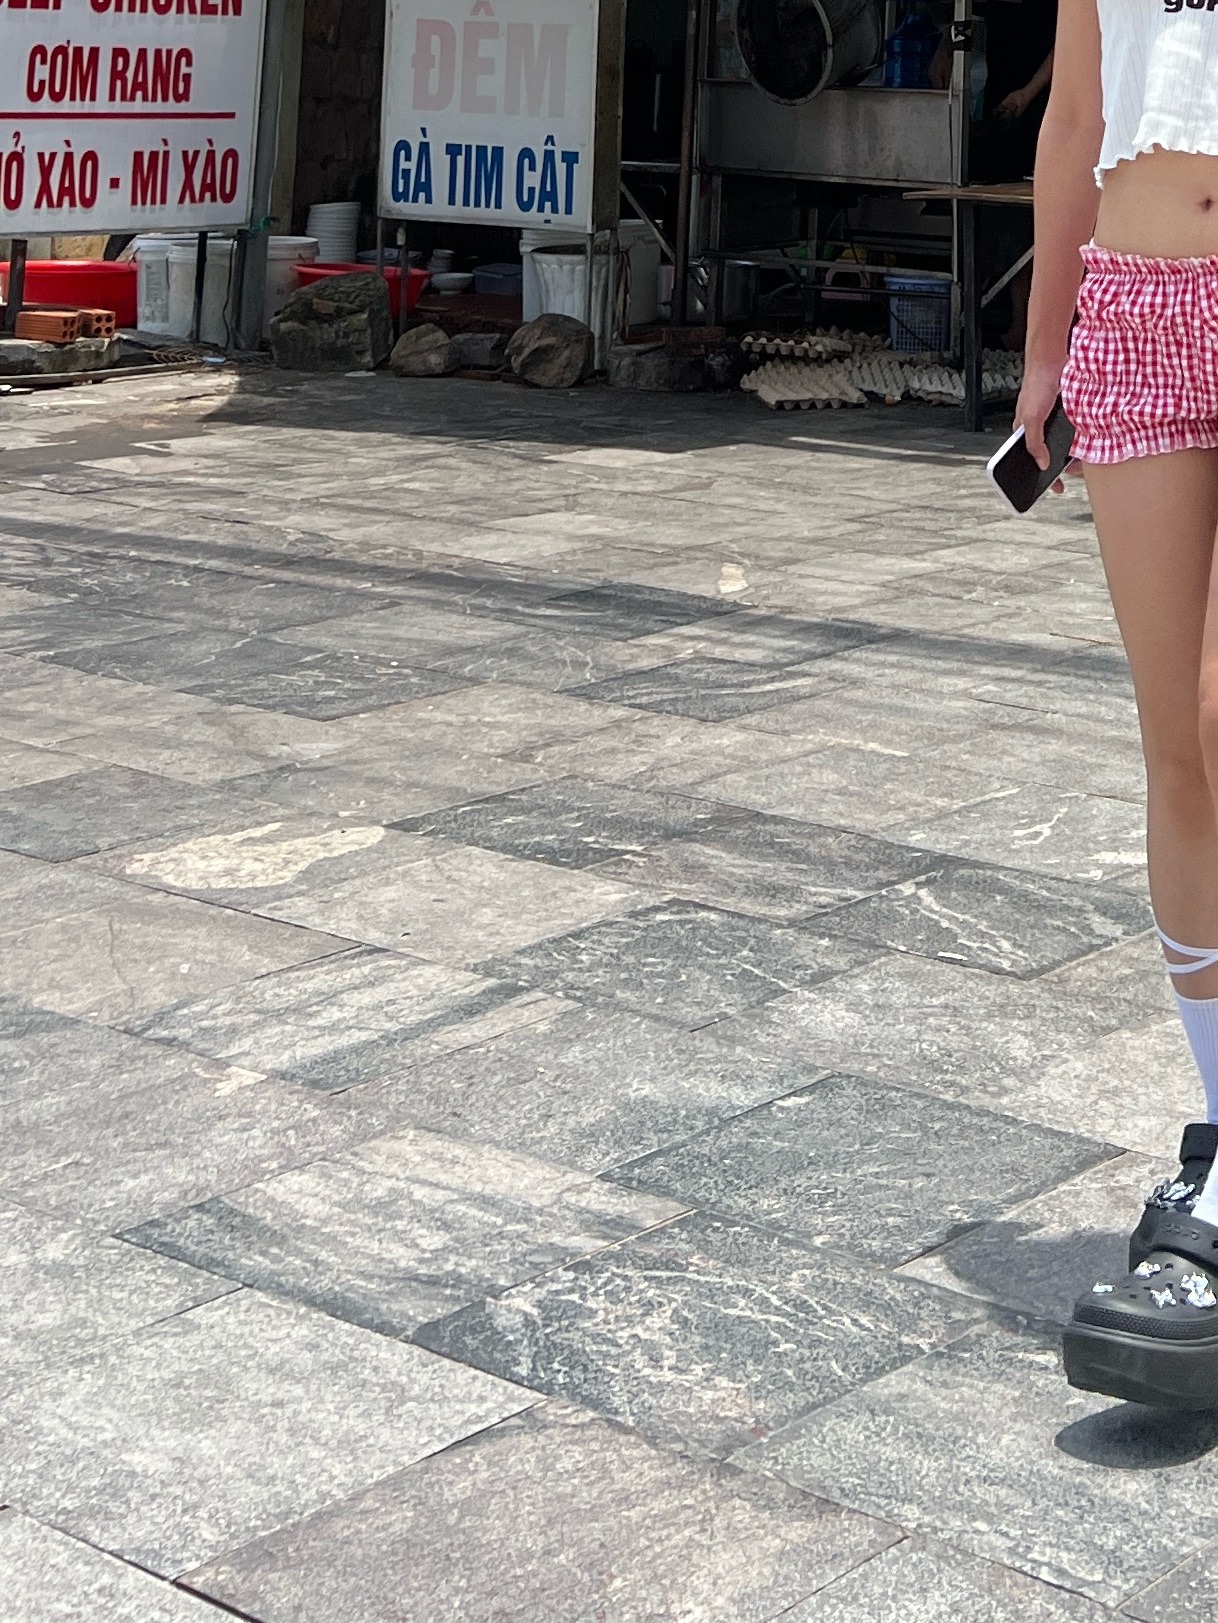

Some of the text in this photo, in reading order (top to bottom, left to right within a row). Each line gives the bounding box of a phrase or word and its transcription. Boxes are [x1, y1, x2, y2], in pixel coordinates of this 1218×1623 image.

[26, 39, 193, 104] CƠM RANG
[411, 0, 569, 118] ĐÊM
[34, 140, 99, 209] XÀO
[131, 138, 171, 207] MÌ
[178, 138, 240, 205] XÀO
[391, 127, 580, 225] GÀ TIM CẬT
